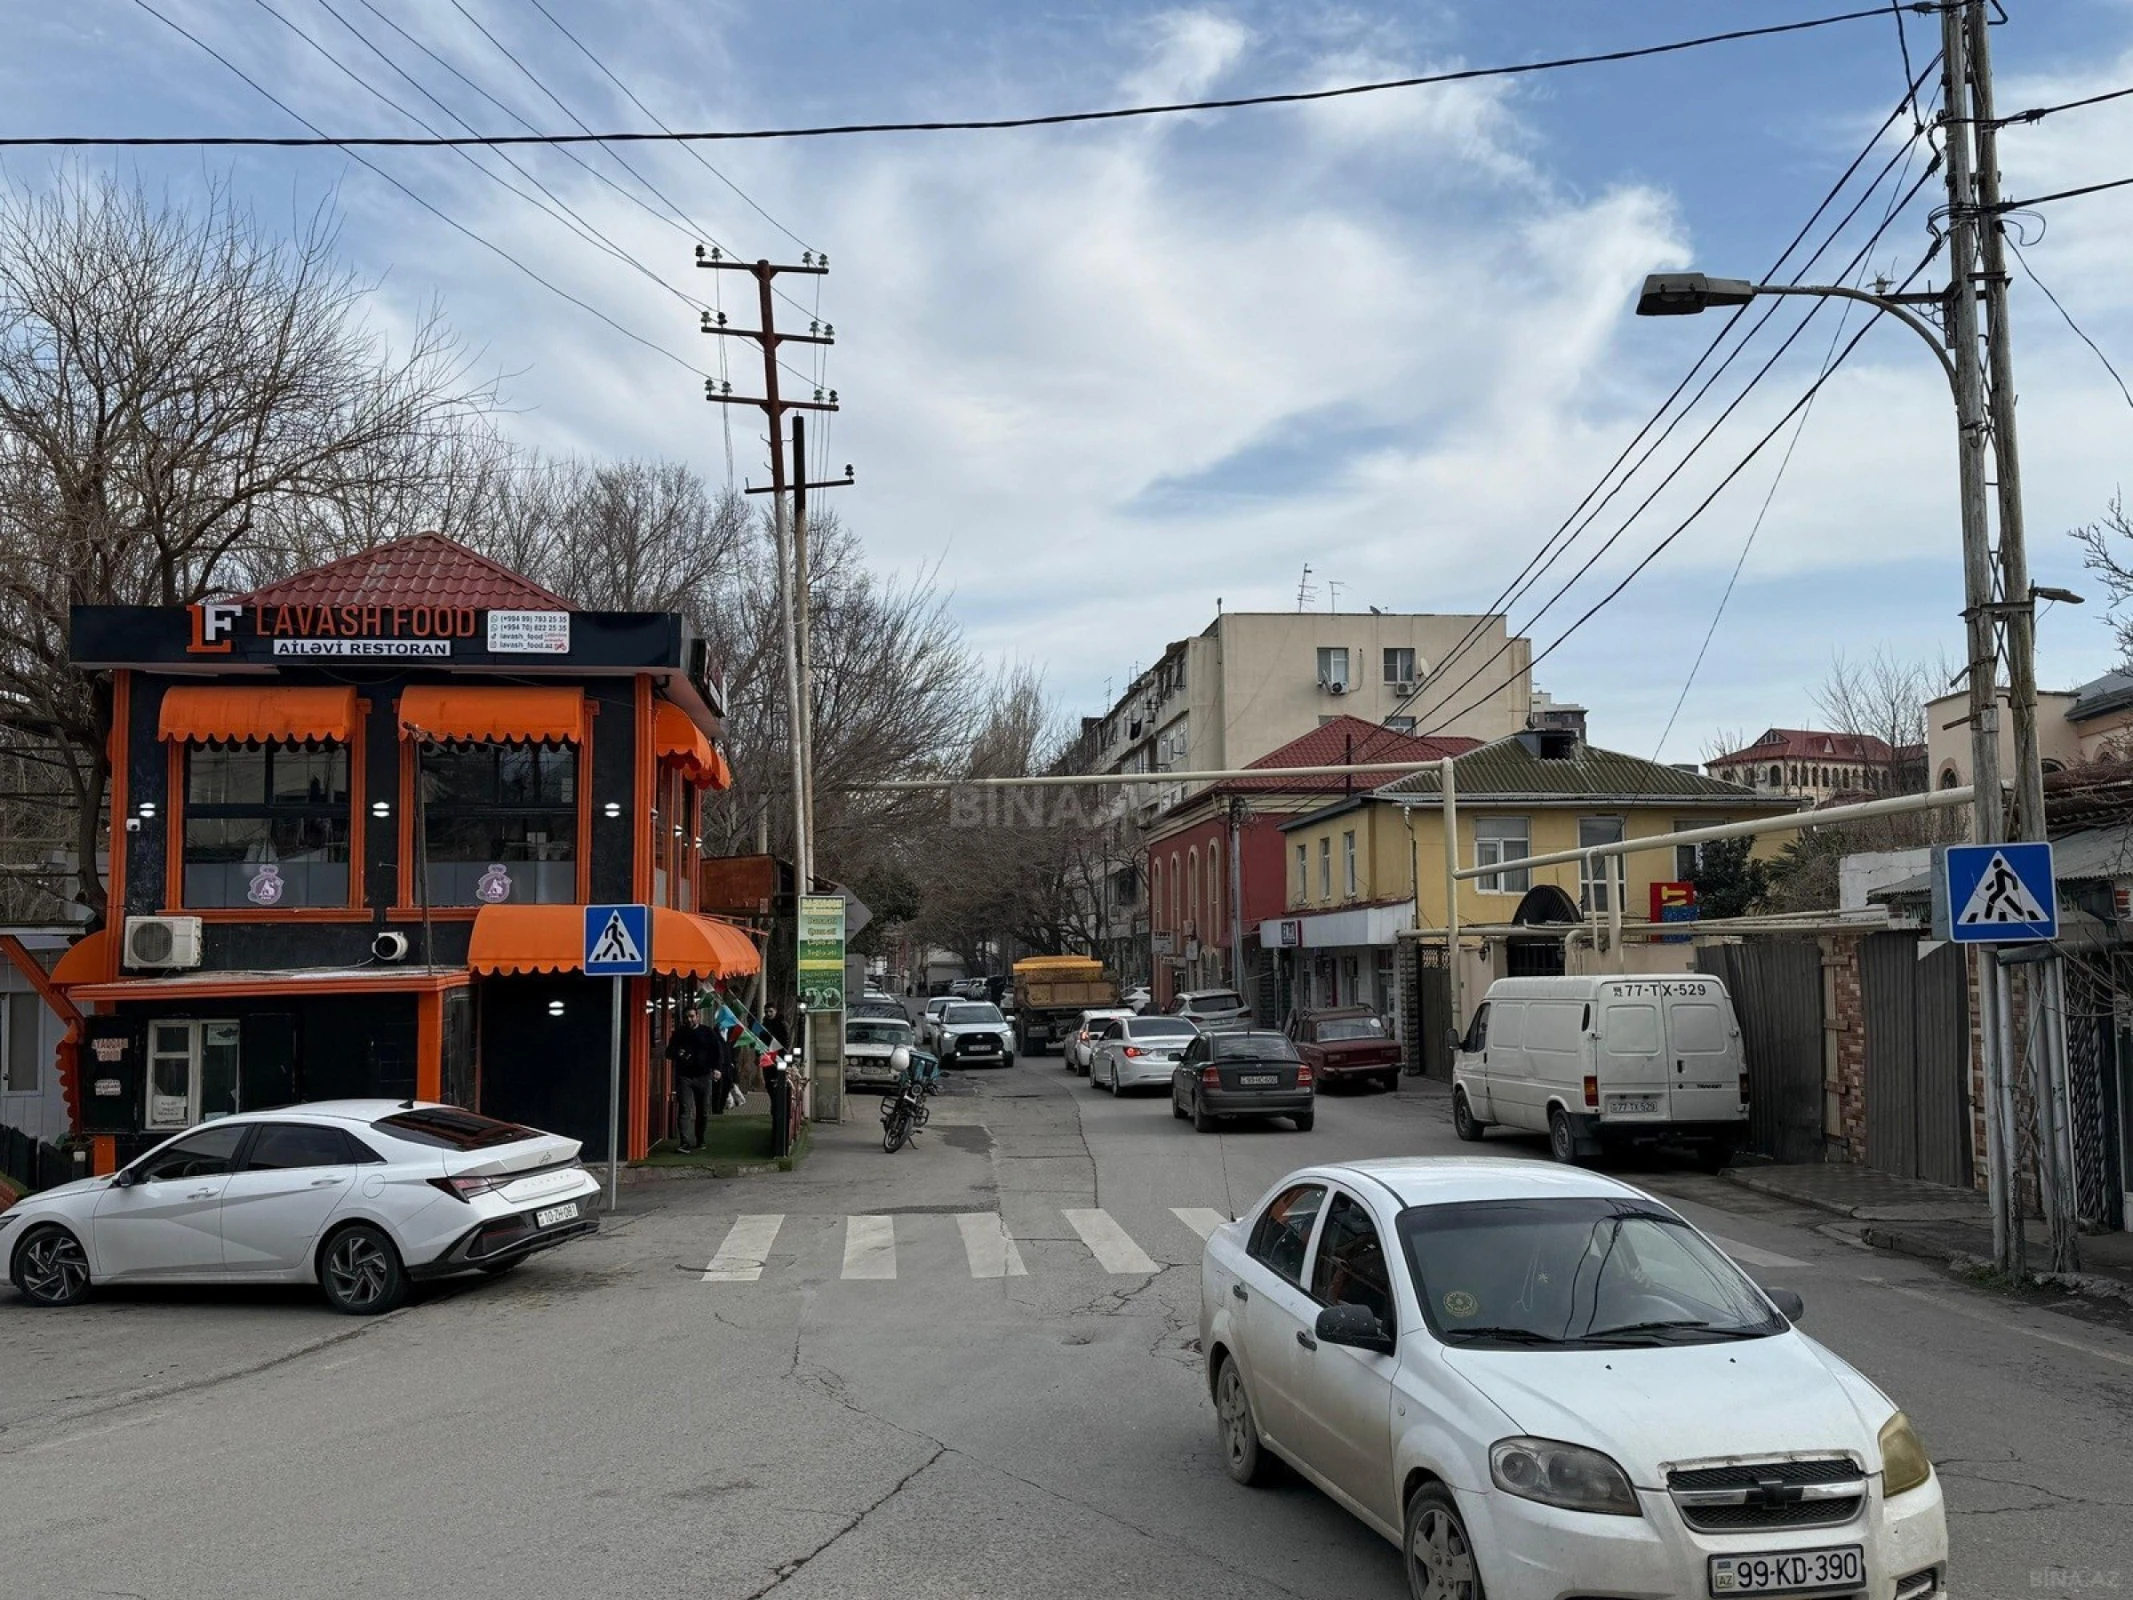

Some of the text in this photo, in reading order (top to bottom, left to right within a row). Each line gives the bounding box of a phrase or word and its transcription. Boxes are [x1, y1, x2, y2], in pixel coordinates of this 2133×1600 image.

[256, 604, 475, 637] LAVASH FOOD
[278, 640, 447, 655] AİLƏVİ RESTORAN
[1625, 983, 1706, 996] 77-TX-529
[1737, 1552, 1857, 1588] 99-KD-390
